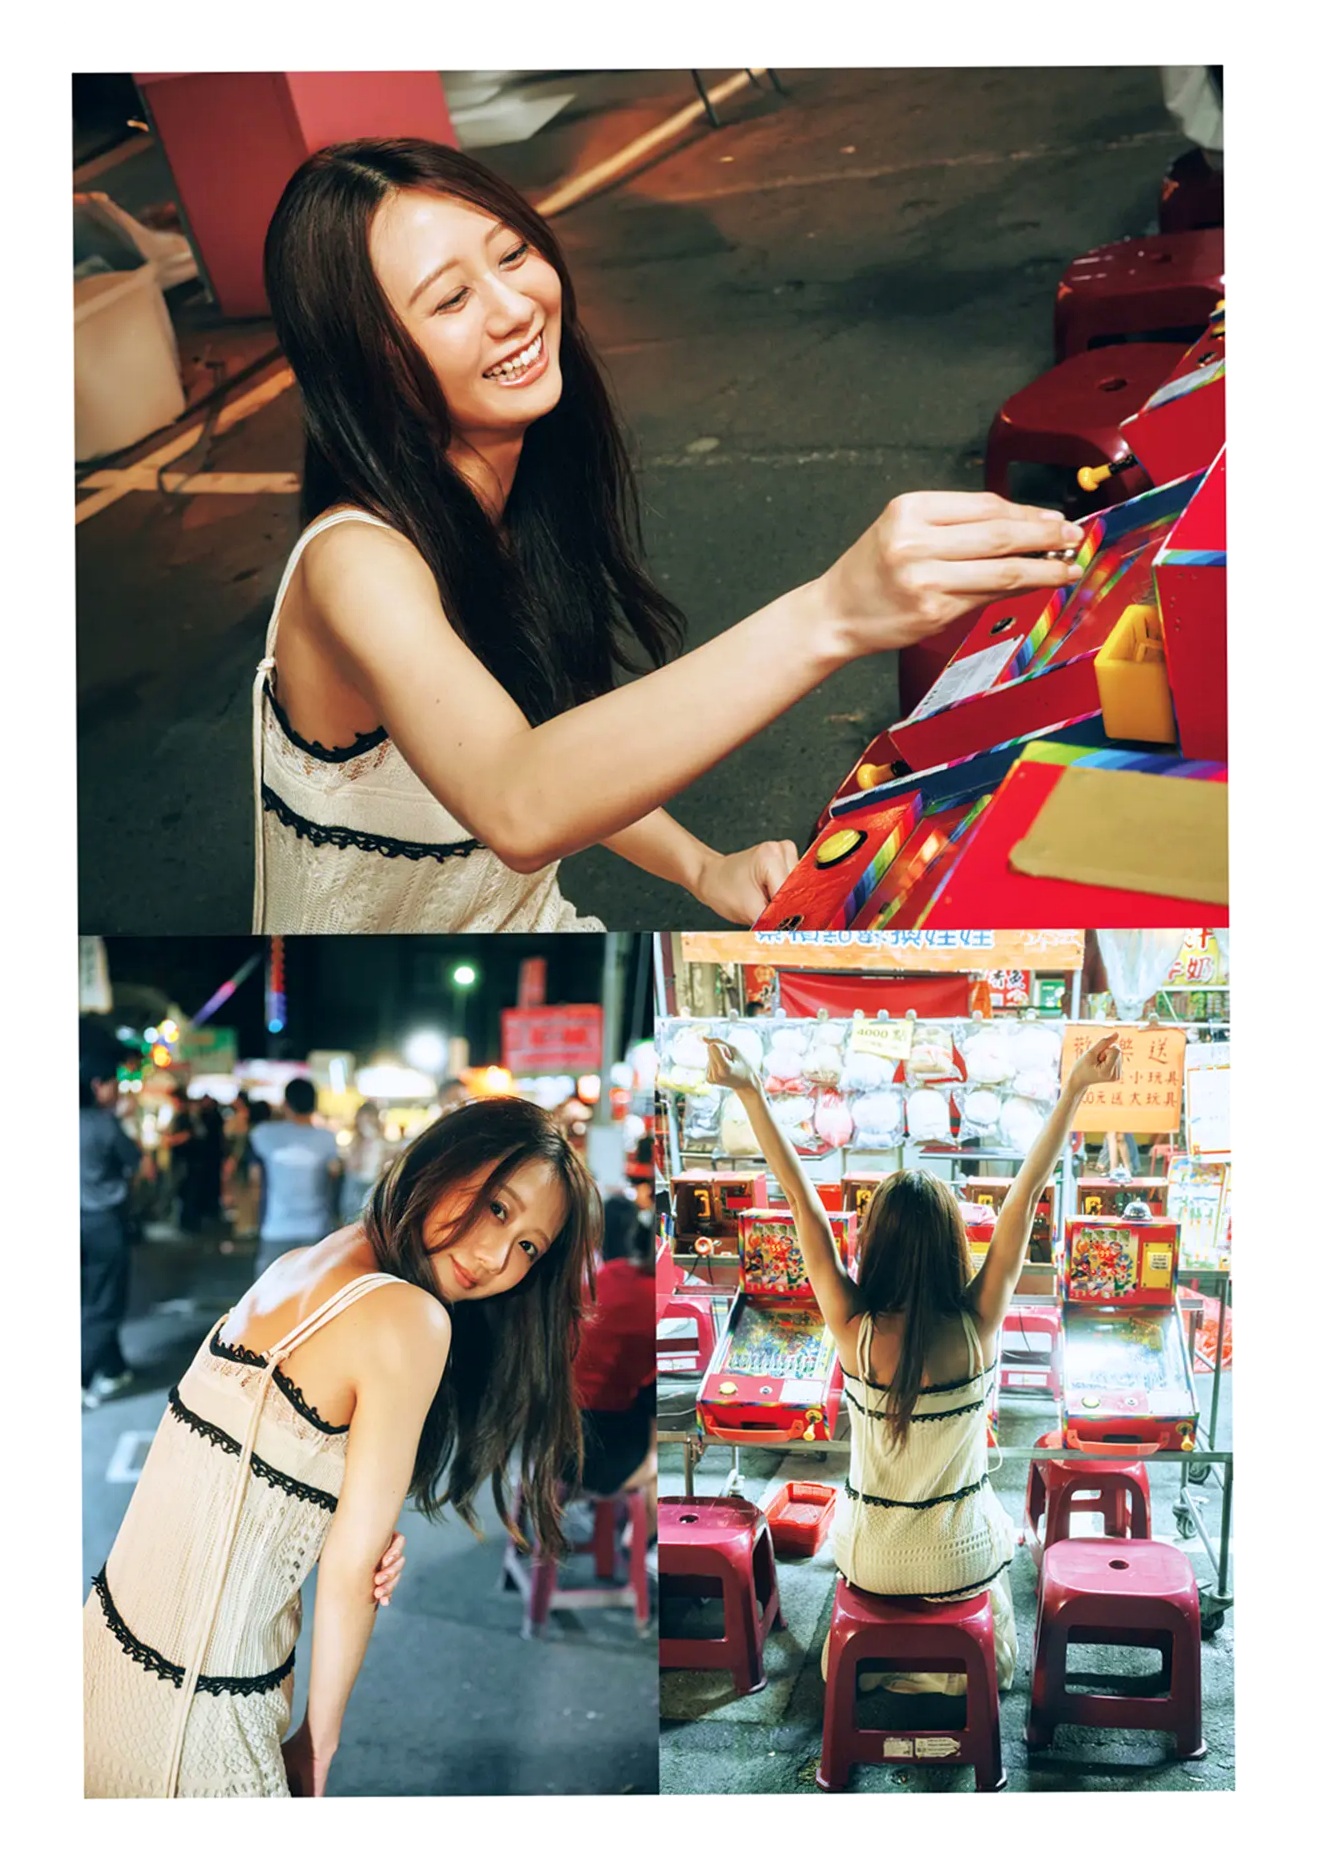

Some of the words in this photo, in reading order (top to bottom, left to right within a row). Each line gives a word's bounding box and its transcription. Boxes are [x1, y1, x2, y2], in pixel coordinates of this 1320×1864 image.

[856, 1028, 889, 1039] 4000
[1121, 1070, 1180, 1086] 小玩具
